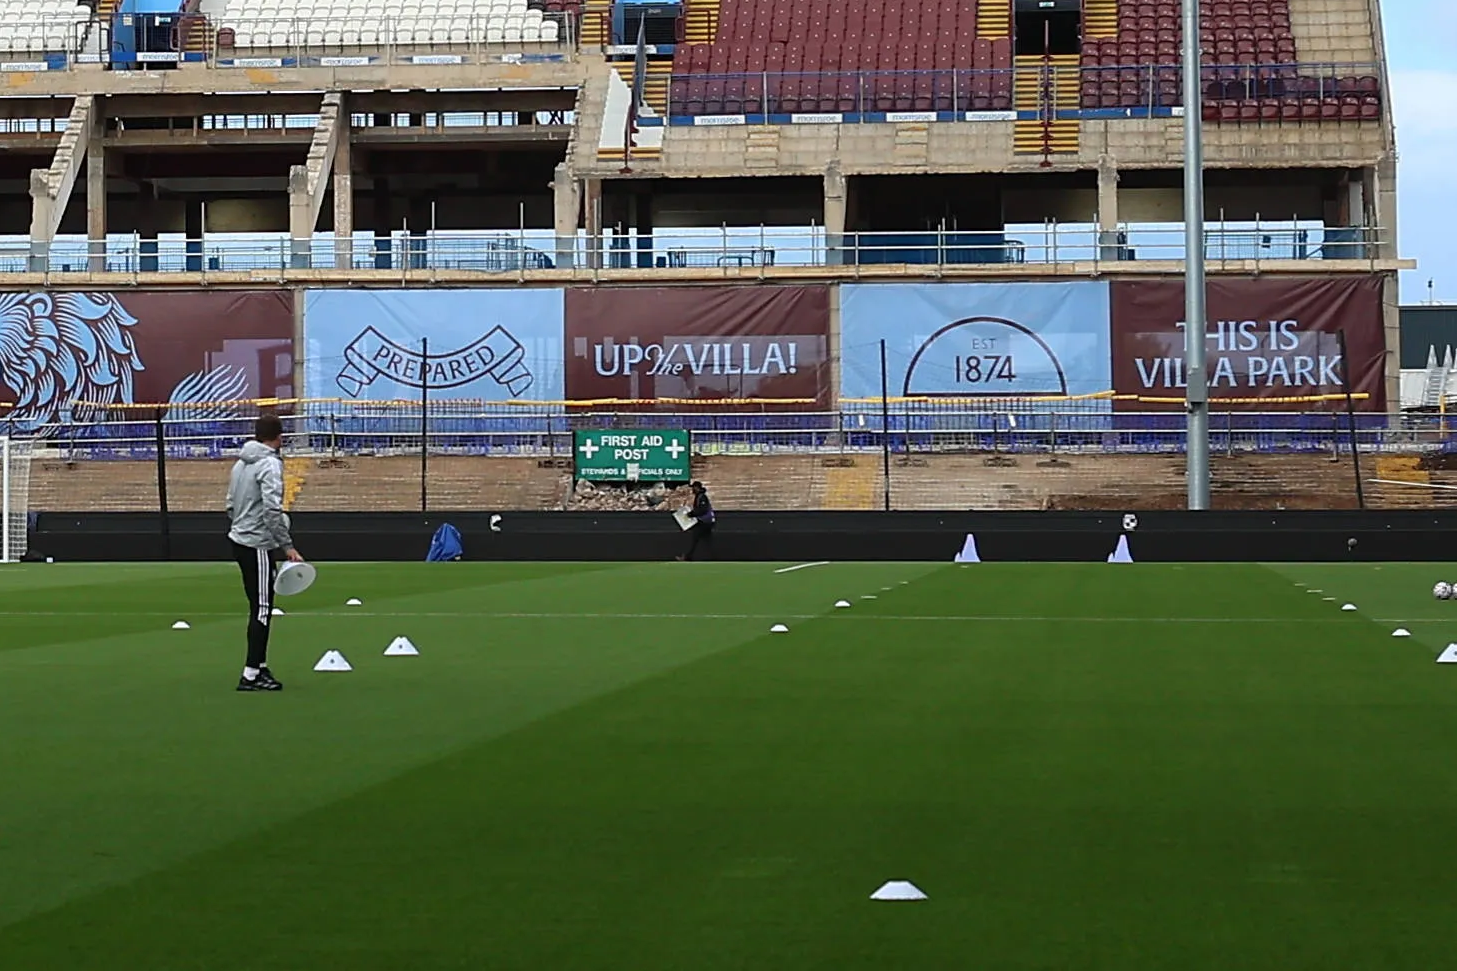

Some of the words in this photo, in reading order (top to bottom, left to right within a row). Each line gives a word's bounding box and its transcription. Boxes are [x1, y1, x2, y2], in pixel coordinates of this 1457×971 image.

[972, 338, 996, 350] EST
[1269, 320, 1299, 351] IS
[373, 345, 495, 382] PREPARED
[594, 343, 643, 375] UP
[644, 343, 684, 375] The
[683, 342, 797, 375] VILLA!
[955, 355, 1017, 383] 1874
[1135, 357, 1238, 387] VILA
[1247, 355, 1343, 387] PARK
[601, 435, 637, 446] FIRST
[641, 435, 663, 446] AID
[614, 449, 649, 460] POST
[665, 468, 683, 476] ONLY
